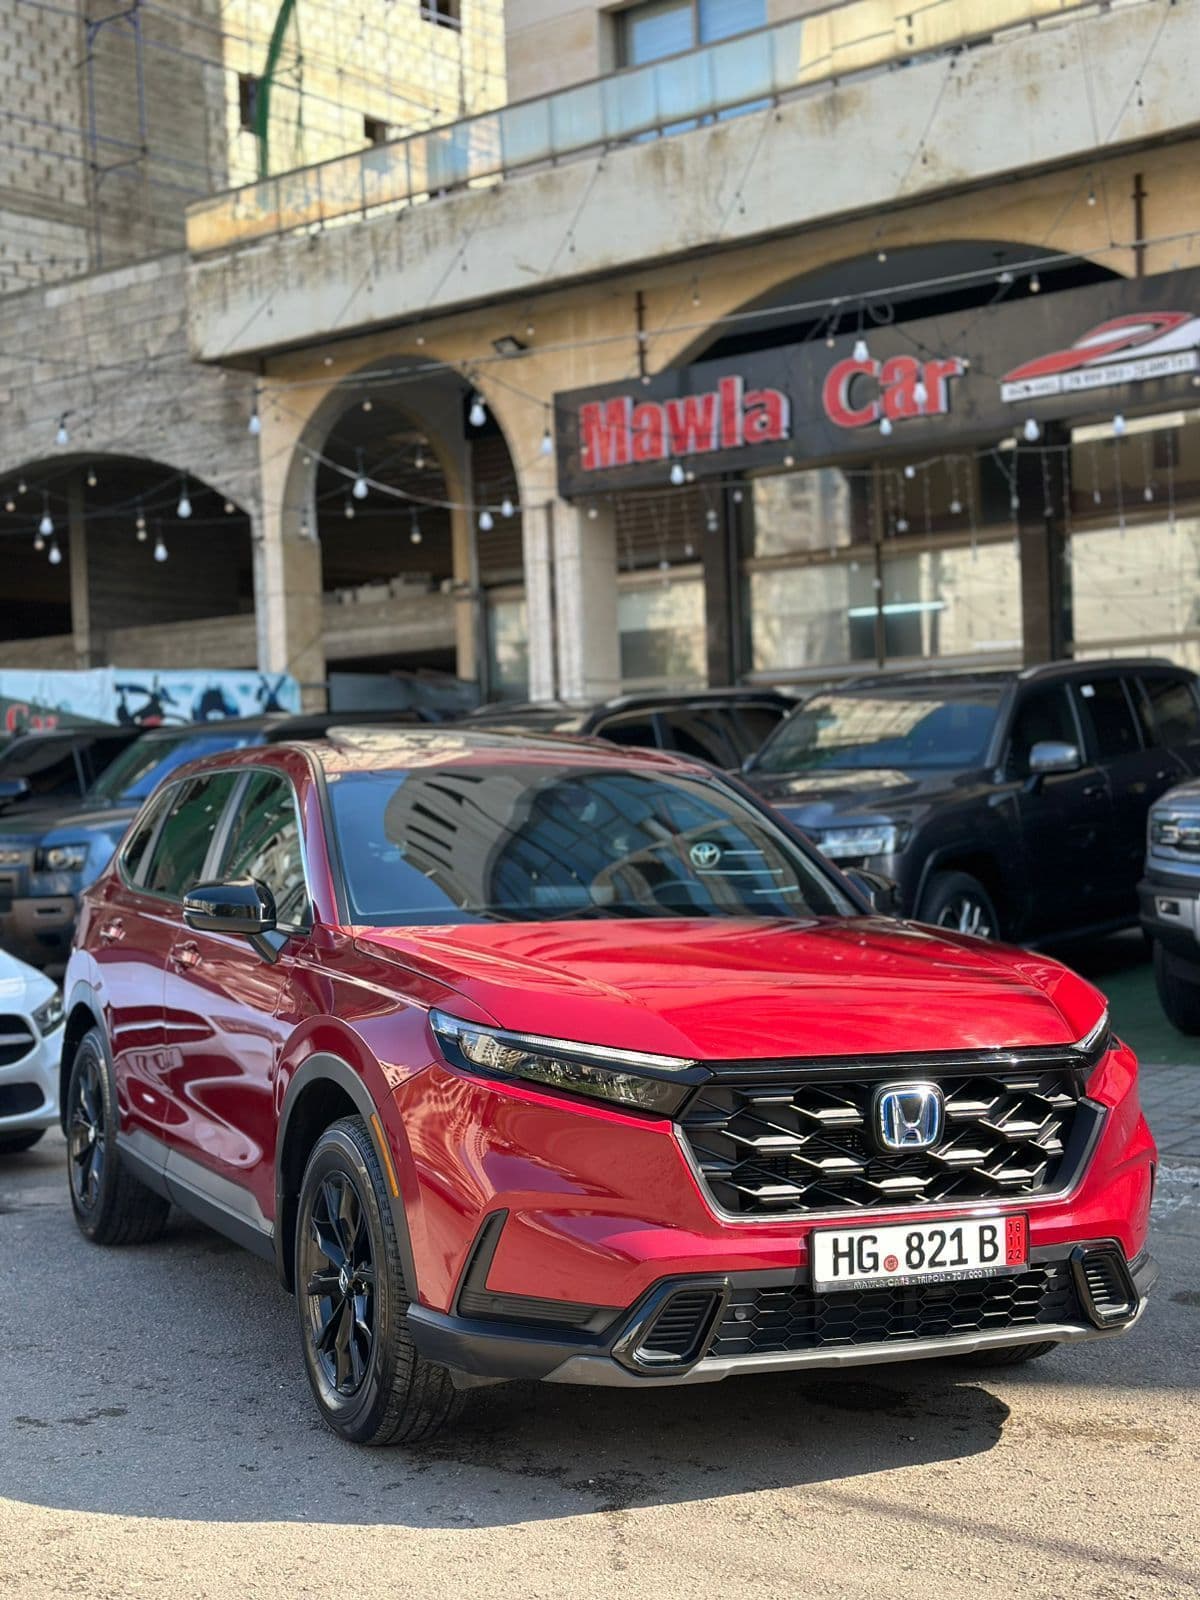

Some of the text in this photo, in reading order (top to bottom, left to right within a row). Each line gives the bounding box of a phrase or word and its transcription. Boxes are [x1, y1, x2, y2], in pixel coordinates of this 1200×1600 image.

[578, 355, 965, 471] Mawla Car
[1008, 1222, 1021, 1233] 18
[1009, 1235, 1021, 1246] 11
[832, 1225, 999, 1276] HG 821 B
[1008, 1249, 1022, 1260] 22
